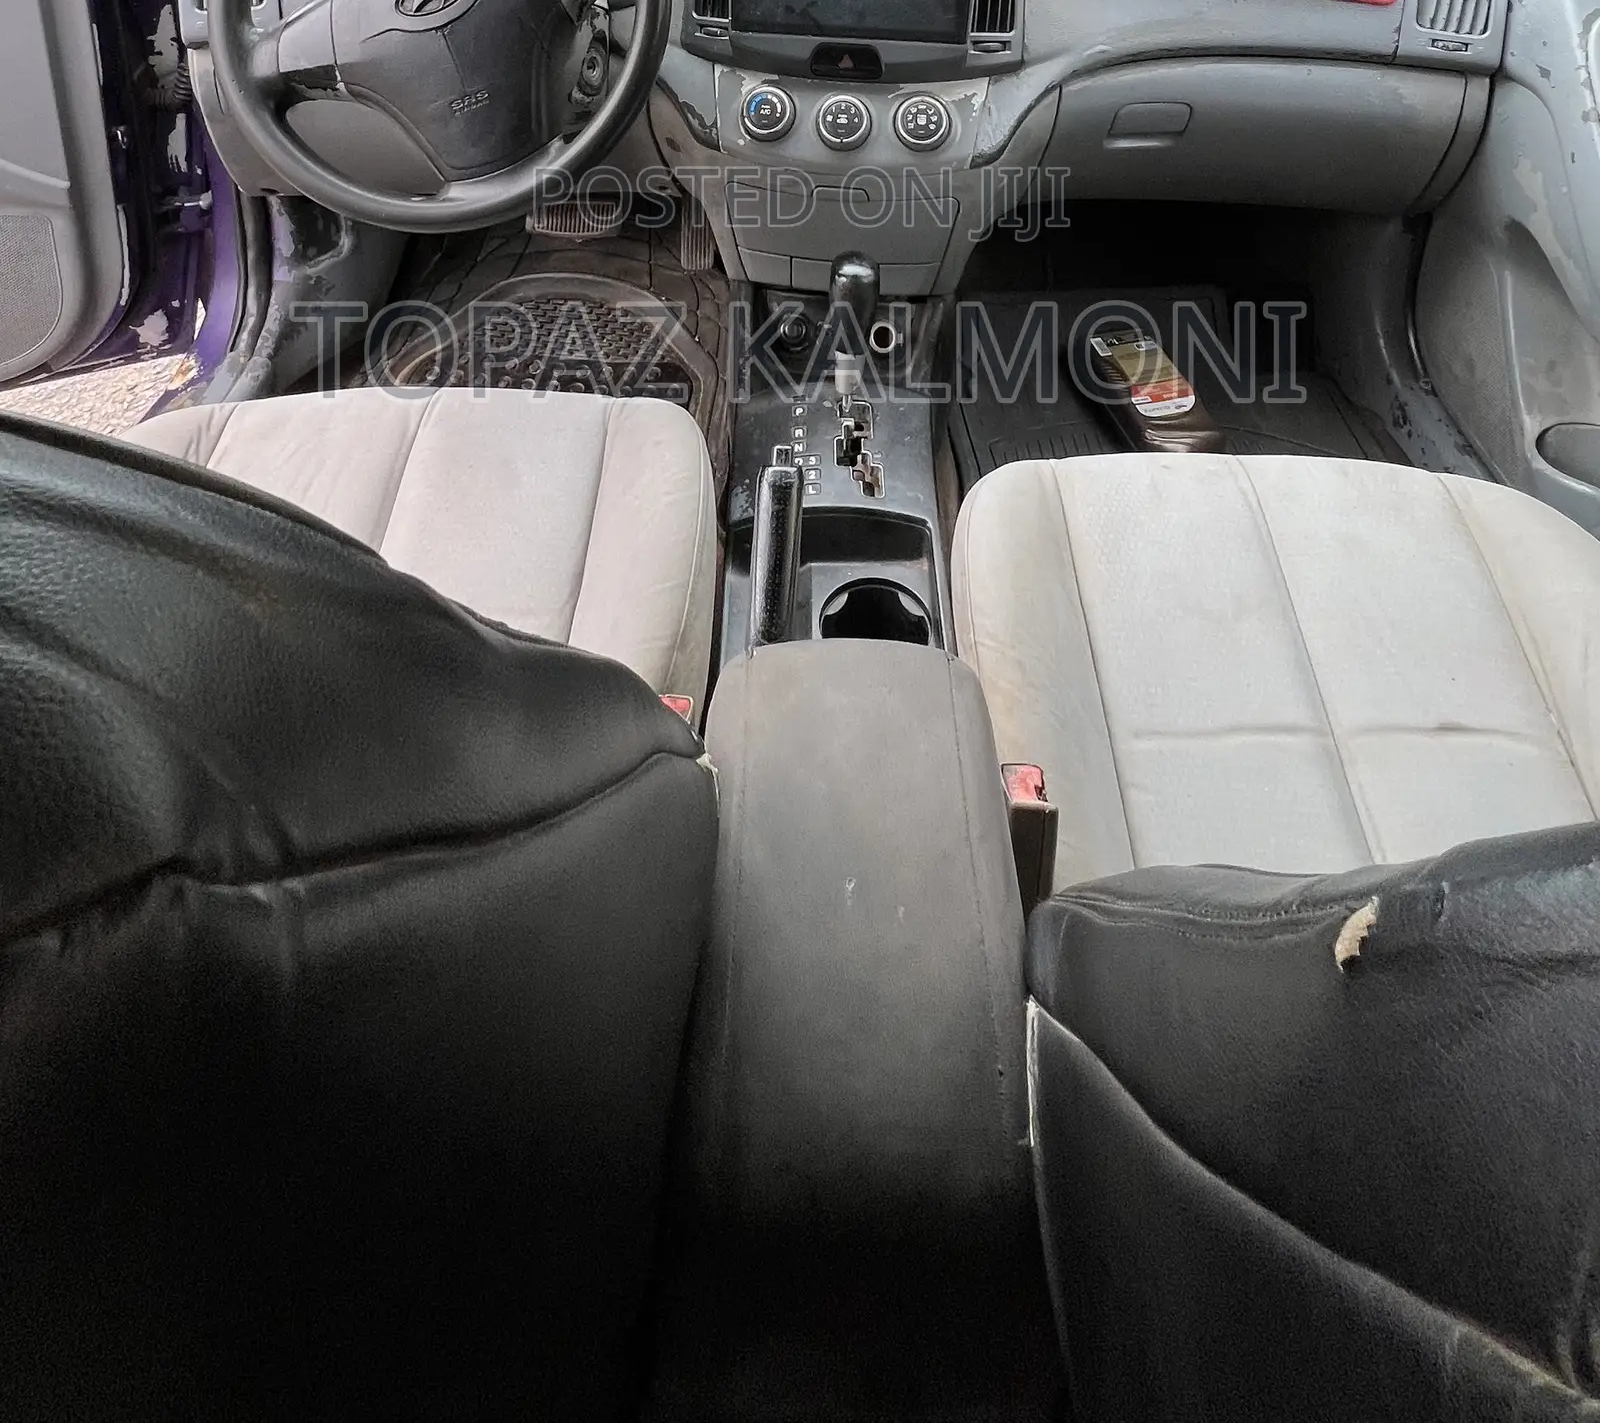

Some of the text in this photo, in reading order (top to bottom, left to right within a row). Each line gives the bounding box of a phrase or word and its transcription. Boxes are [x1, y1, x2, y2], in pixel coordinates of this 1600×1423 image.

[795, 407, 804, 417] P
[794, 428, 804, 438] R
[794, 443, 803, 452] N
[808, 456, 816, 465] 3
[808, 471, 817, 480] 2
[808, 484, 817, 494] L
